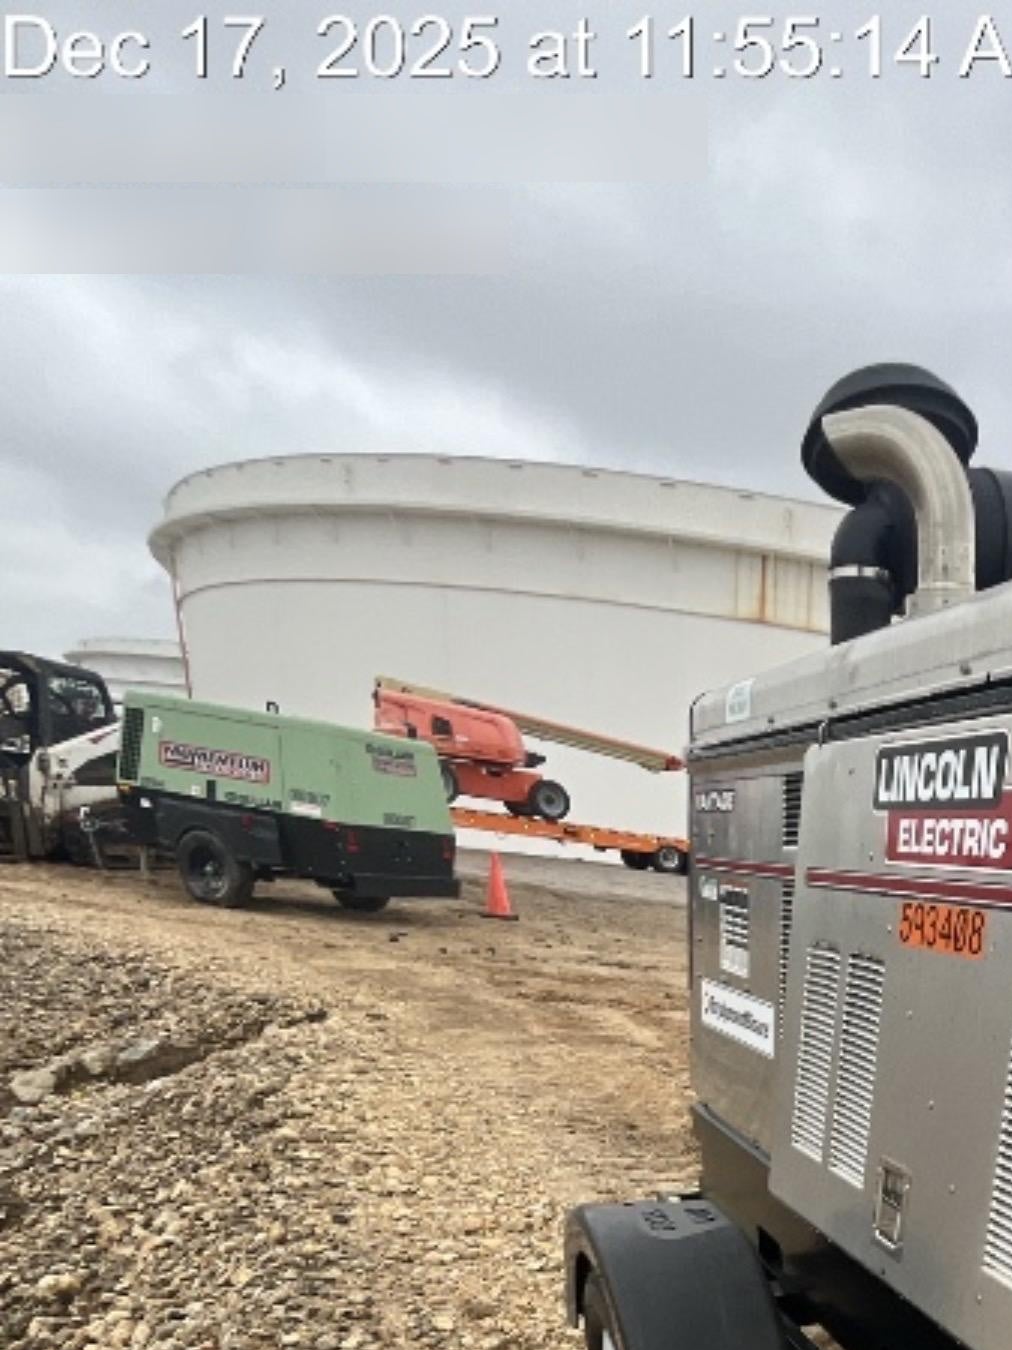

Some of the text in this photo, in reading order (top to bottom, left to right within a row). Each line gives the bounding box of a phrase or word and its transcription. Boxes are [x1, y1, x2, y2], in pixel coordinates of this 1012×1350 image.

[878, 745, 1003, 803] LINCOLN
[896, 817, 1010, 858] ELECTRIC
[899, 903, 987, 956] 593408
